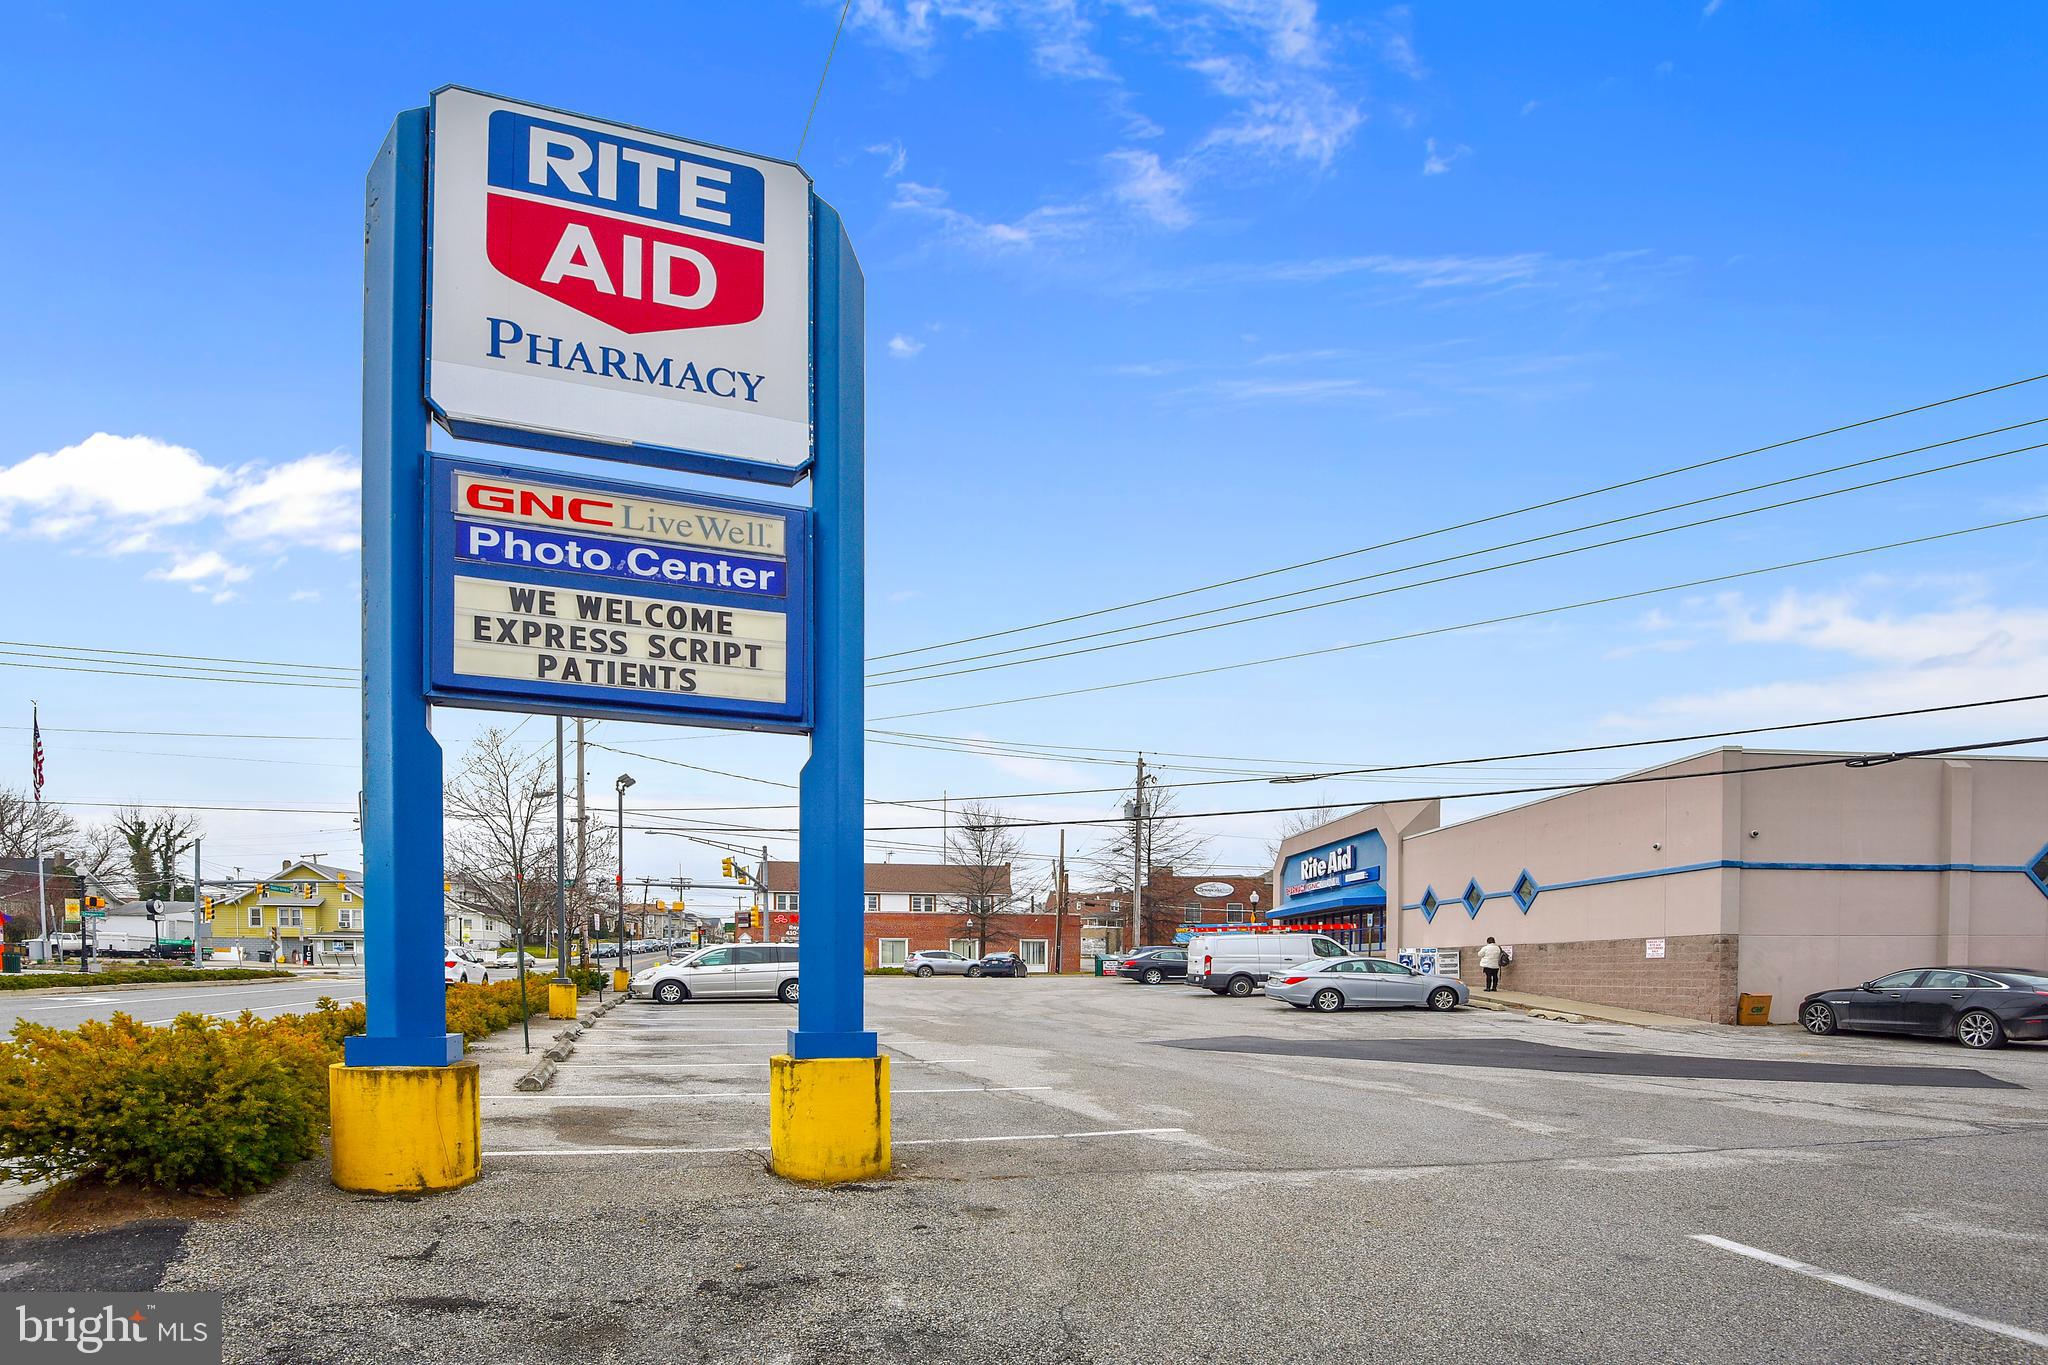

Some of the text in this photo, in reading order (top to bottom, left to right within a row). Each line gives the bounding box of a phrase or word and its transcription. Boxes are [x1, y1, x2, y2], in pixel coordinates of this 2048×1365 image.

[528, 126, 732, 226] RITE
[540, 223, 717, 310] AID
[486, 317, 766, 403] PHARMACY
[467, 484, 613, 526] GNC
[469, 526, 775, 590] Photo Center
[509, 587, 733, 635] WE WELCOME
[474, 615, 762, 668] EXPRESS SCRIPT
[538, 654, 697, 692] PATIENTS
[1300, 857, 1327, 880] Rite
[1327, 845, 1352, 874] Aid
